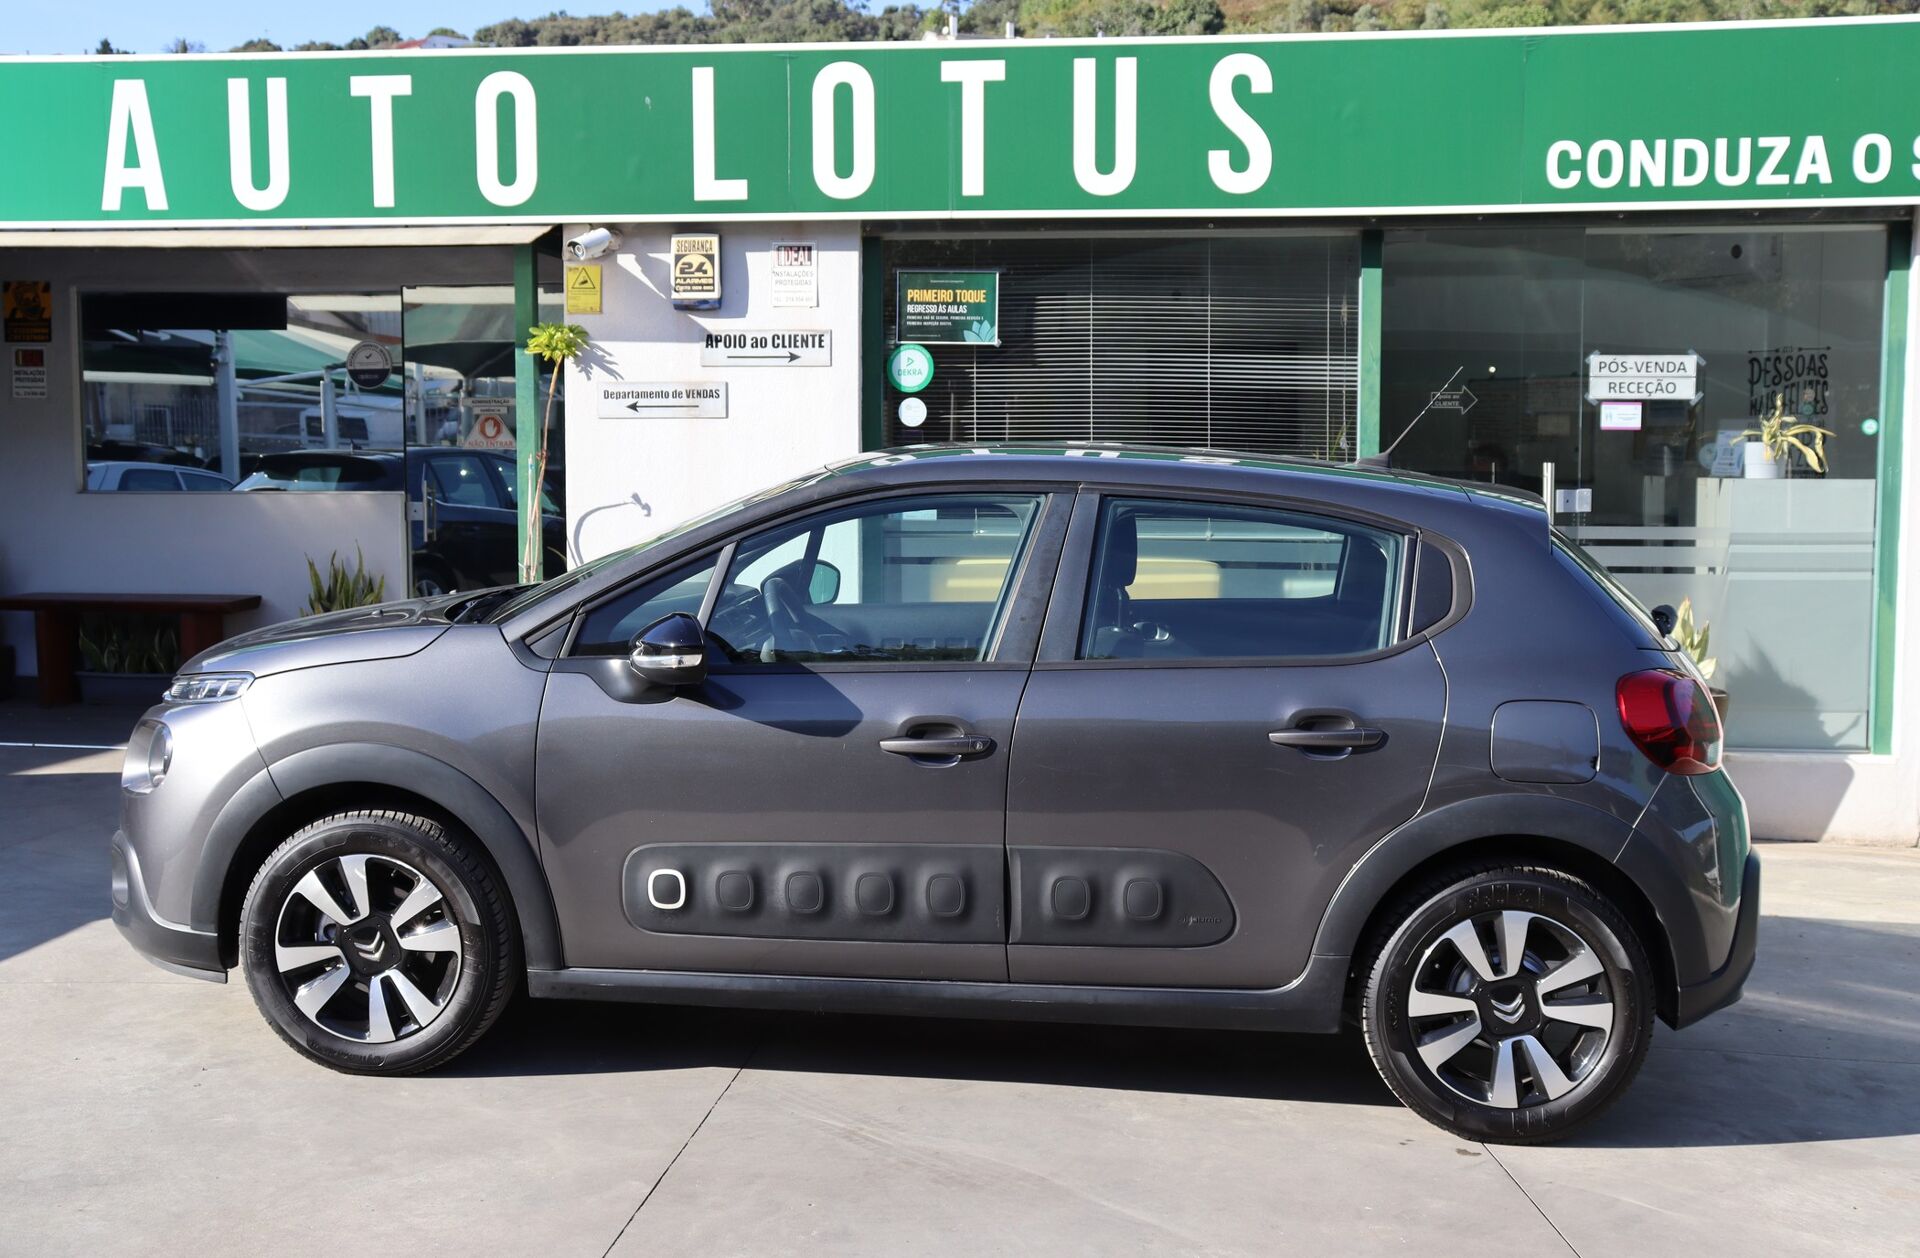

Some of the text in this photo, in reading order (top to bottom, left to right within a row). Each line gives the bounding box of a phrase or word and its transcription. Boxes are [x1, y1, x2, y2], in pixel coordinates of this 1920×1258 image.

[101, 52, 1273, 211] AUTO LOTUS
[1546, 135, 1832, 189] CONDUZA
[1852, 133, 1892, 184] O
[778, 246, 812, 266] IDEAL
[680, 262, 708, 275] 24
[773, 269, 814, 278] INSTALAÇÕES
[907, 289, 987, 303] PRIMEIRO TOQUE
[906, 305, 937, 313] REGRESSO
[947, 305, 968, 313] AULAS
[705, 334, 825, 349] APOIO ao CLIENTE
[1598, 358, 1688, 373] PÓS-VENDA
[1748, 354, 1828, 396] PESSOAS
[603, 389, 720, 400] Departamento de VENDAS
[1608, 379, 1677, 397] RECEÇÃO
[468, 440, 513, 448] NÃO ENTRAR
